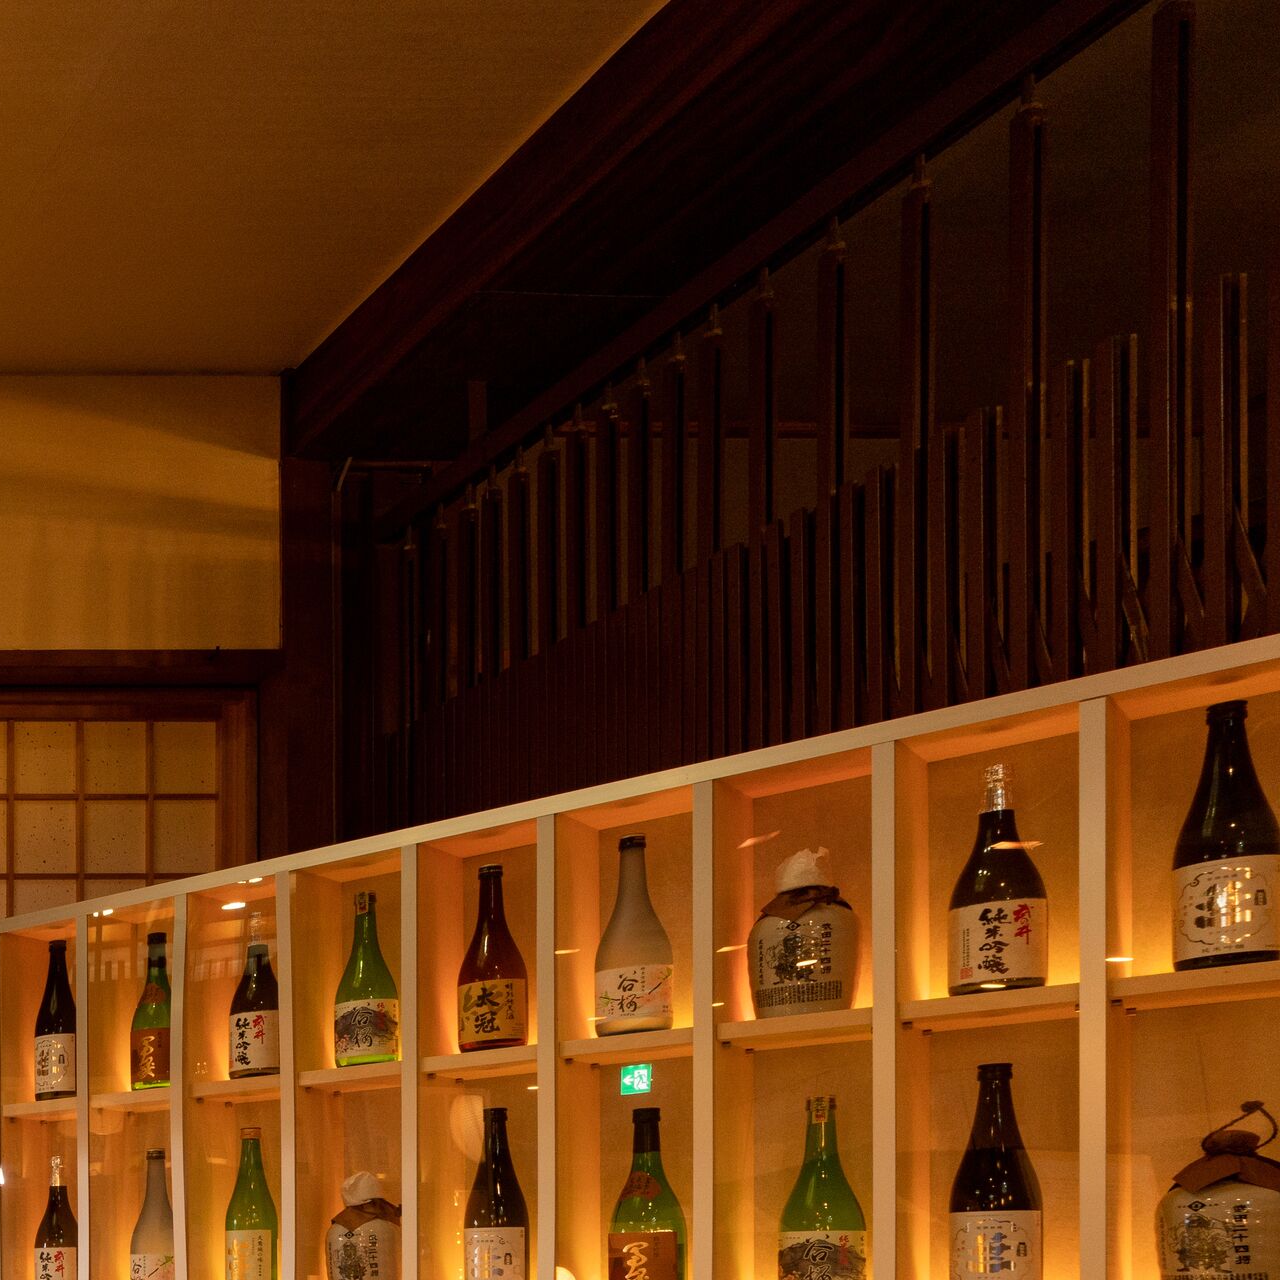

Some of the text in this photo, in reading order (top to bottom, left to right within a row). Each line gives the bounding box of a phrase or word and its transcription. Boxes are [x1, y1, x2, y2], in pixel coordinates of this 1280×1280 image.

[977, 907, 1012, 975] 純米吟醸
[1013, 903, 1035, 945] 武の井
[235, 1017, 252, 1066] 純米吟醸
[252, 1014, 268, 1045] 武の井
[53, 1250, 68, 1278] 武の井
